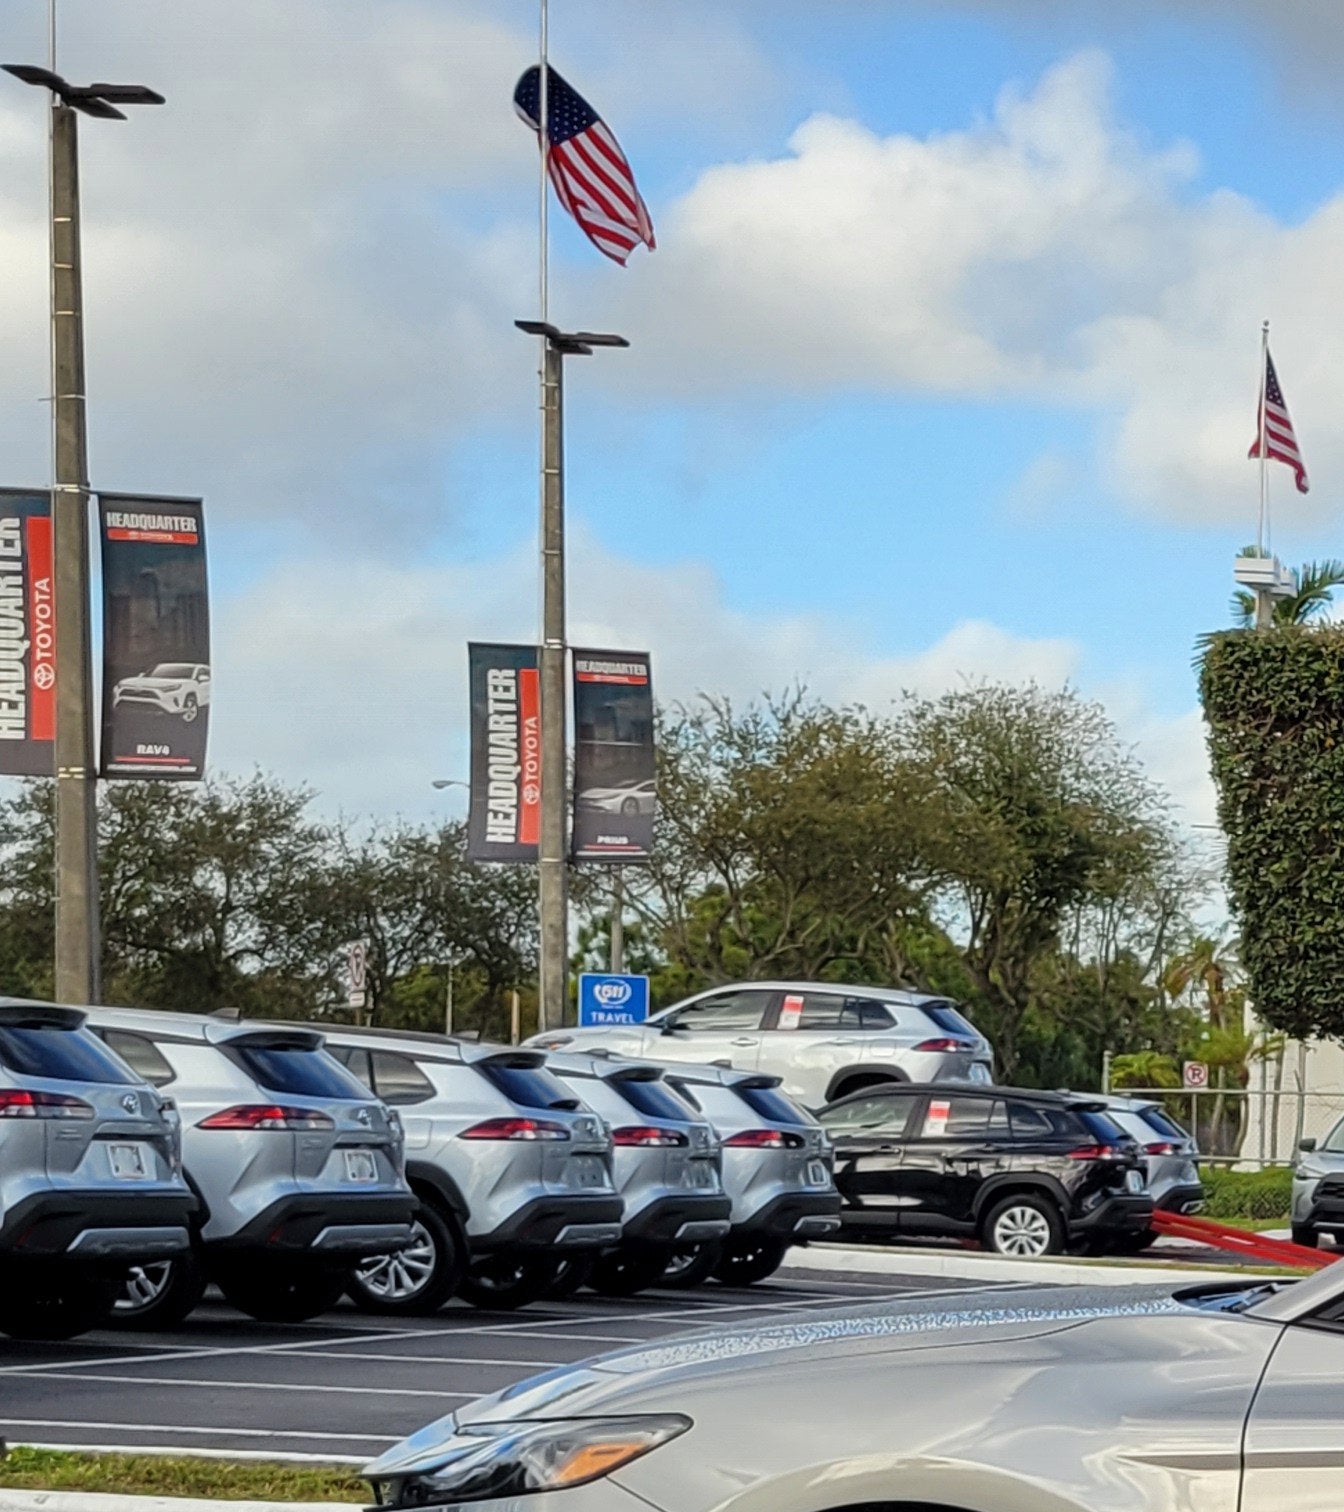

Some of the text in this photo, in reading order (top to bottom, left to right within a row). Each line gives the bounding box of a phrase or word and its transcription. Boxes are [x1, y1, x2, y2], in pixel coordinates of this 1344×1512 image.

[106, 512, 198, 532] HEADQUARTER
[35, 577, 53, 660] TOYOTA
[136, 744, 170, 755] RAV4
[485, 668, 521, 843] HEADQUARTER
[525, 716, 539, 782] TOYOTA
[591, 1011, 636, 1024] TRAVEL
